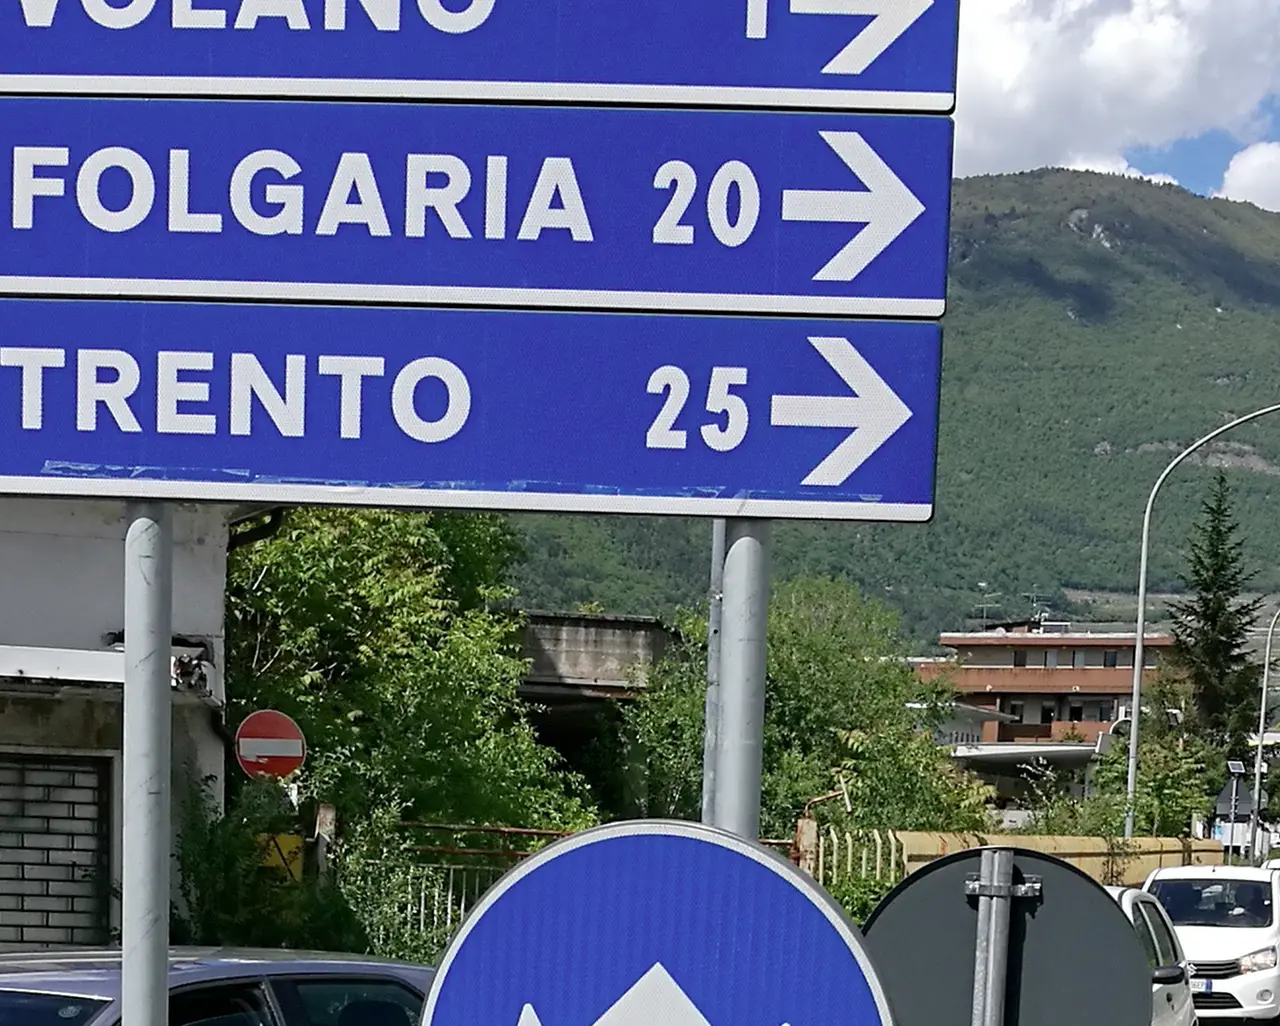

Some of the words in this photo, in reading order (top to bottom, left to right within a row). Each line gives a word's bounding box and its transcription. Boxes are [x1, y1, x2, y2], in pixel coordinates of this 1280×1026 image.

[12, 146, 594, 242] FOLGARIA
[652, 160, 761, 247] 20
[0, 347, 471, 443] TRENTO
[646, 365, 749, 452] 25
